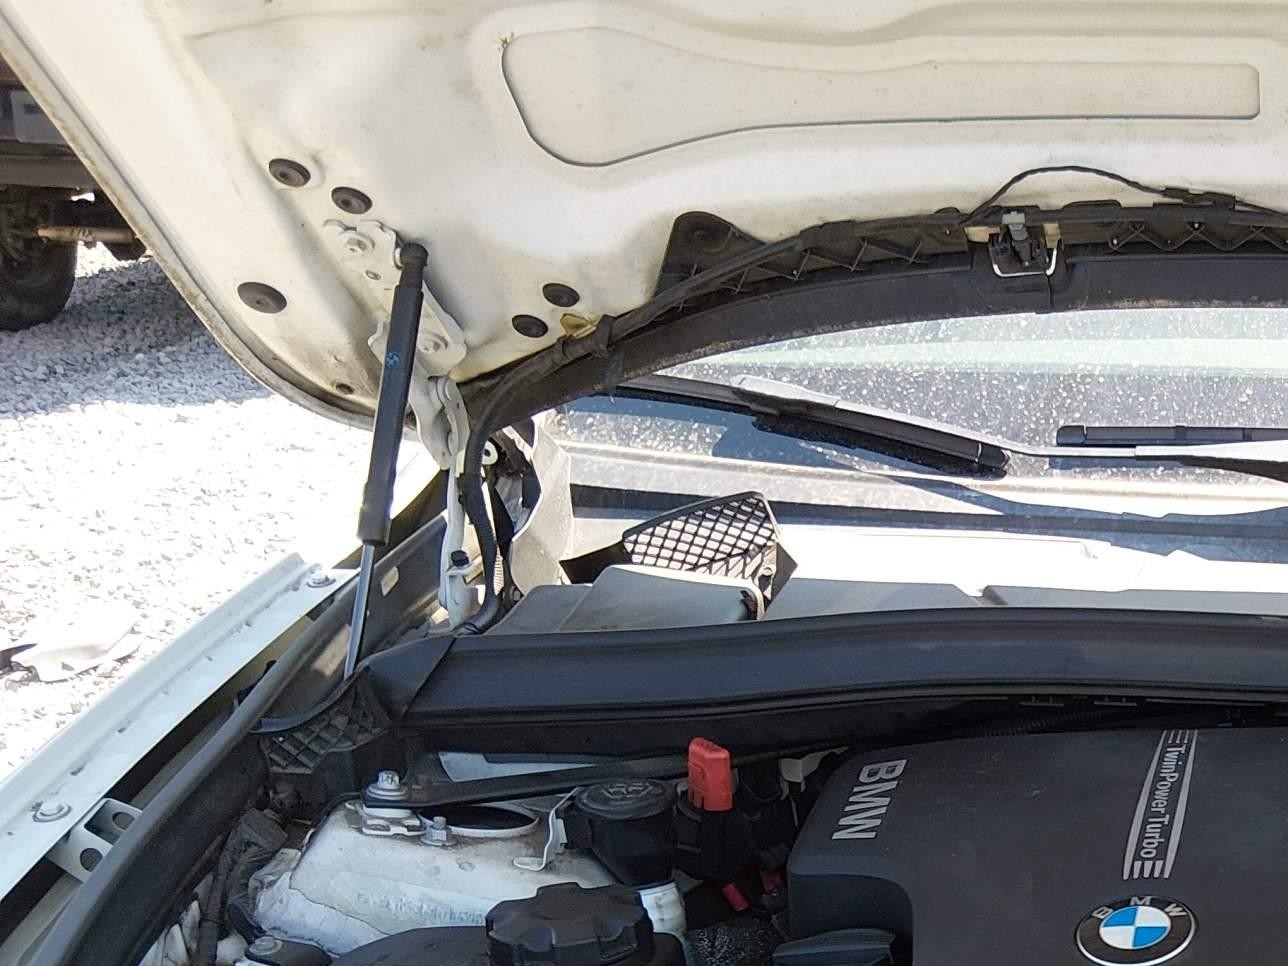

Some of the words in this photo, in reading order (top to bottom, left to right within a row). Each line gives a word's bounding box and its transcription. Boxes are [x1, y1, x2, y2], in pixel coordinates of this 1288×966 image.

[832, 758, 908, 840] BMW
[1151, 743, 1187, 814] TwinPower
[1140, 814, 1170, 858] Turbo
[1092, 896, 1188, 920] BMW
